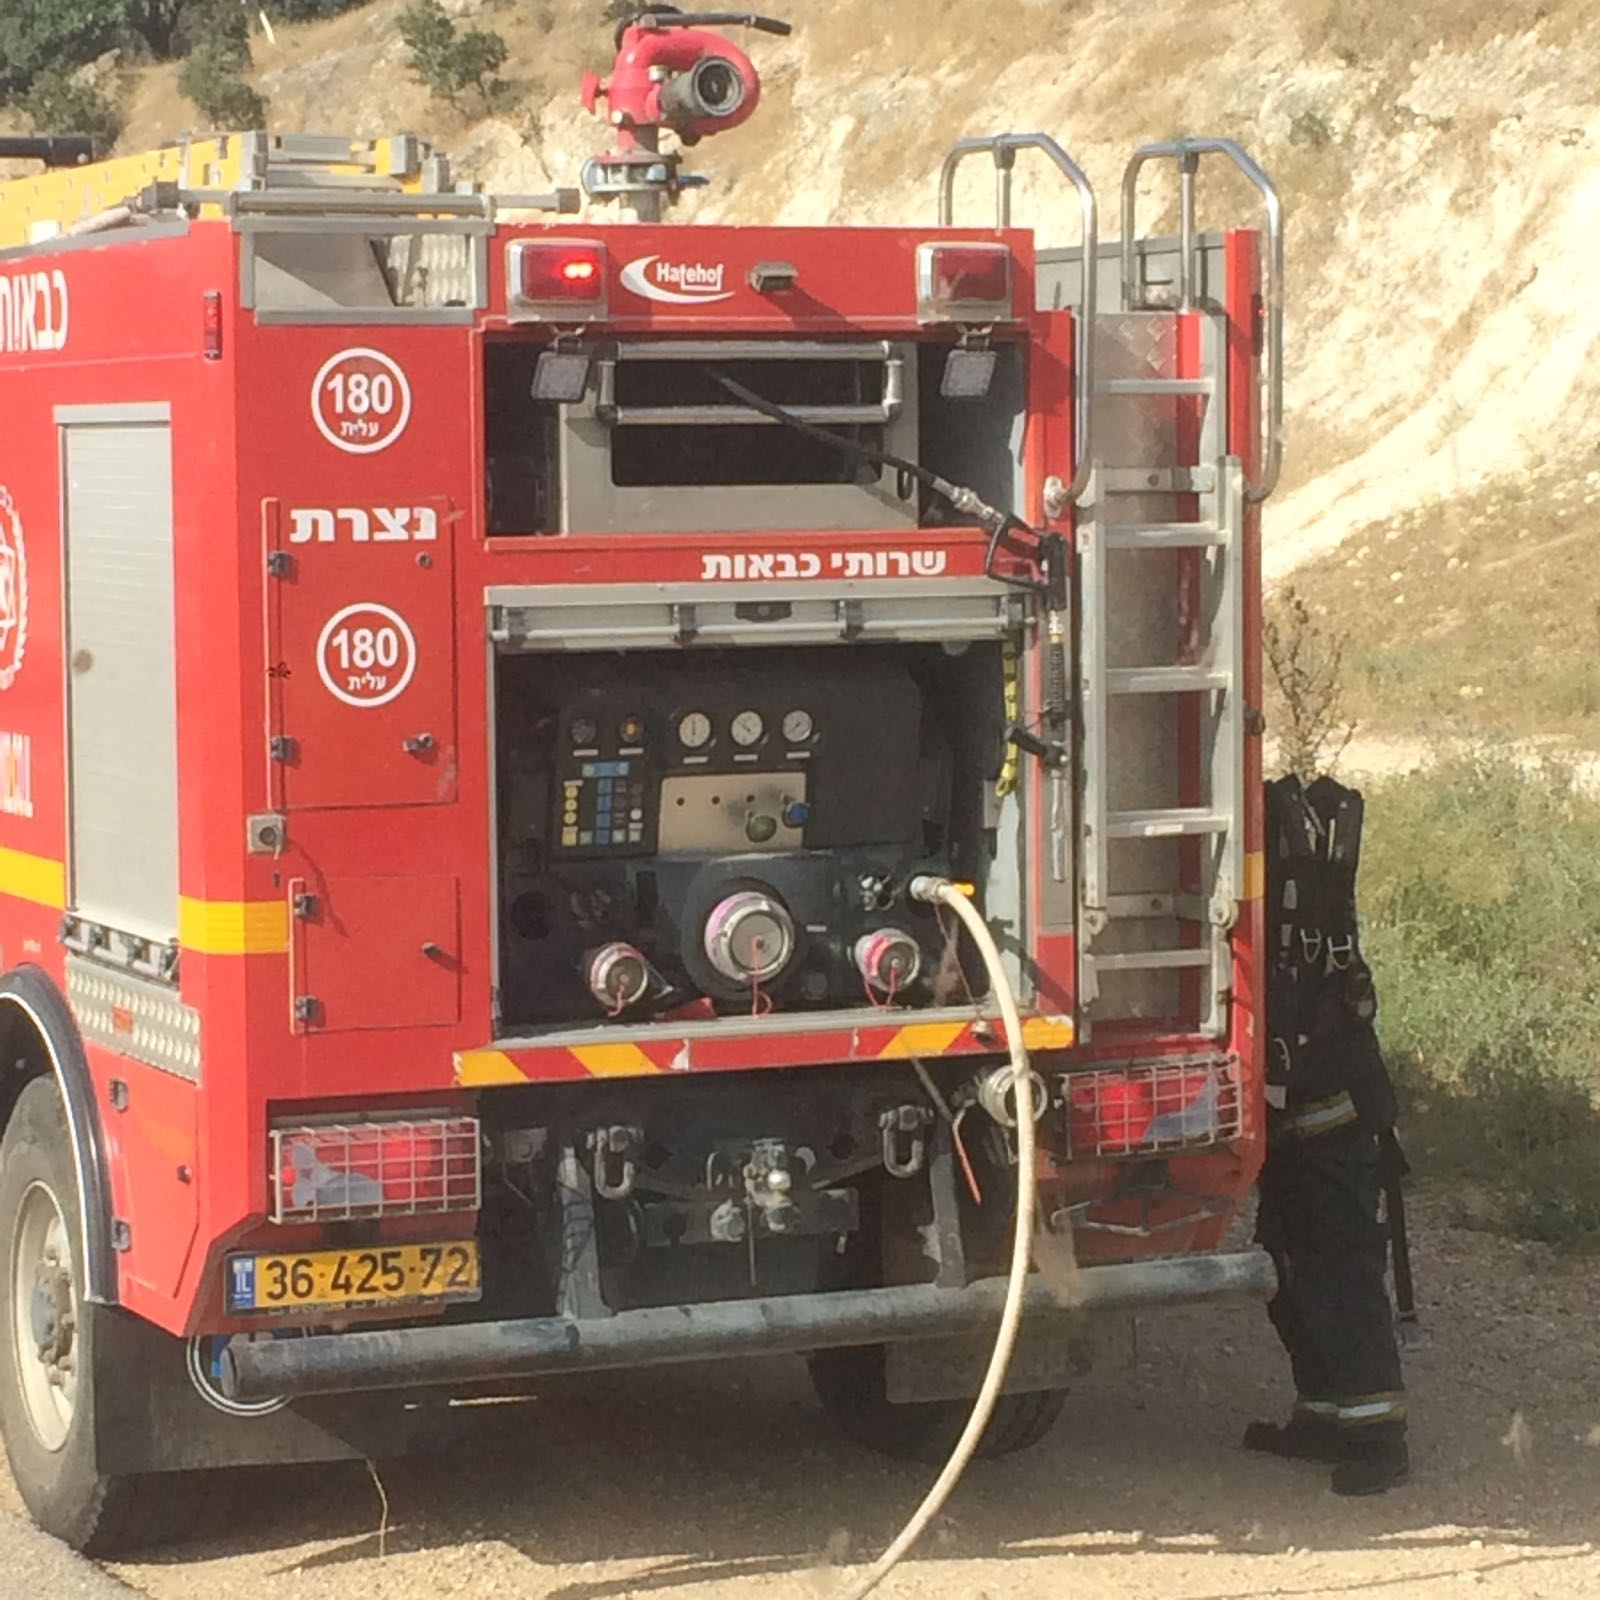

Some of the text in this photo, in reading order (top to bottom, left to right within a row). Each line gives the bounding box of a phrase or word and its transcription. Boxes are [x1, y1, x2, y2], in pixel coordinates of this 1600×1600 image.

[656, 261, 724, 291] Hatehof
[326, 372, 393, 414] 180
[289, 506, 438, 543] נצרת
[701, 551, 946, 579] שרותי כבאות
[332, 627, 399, 669] 180
